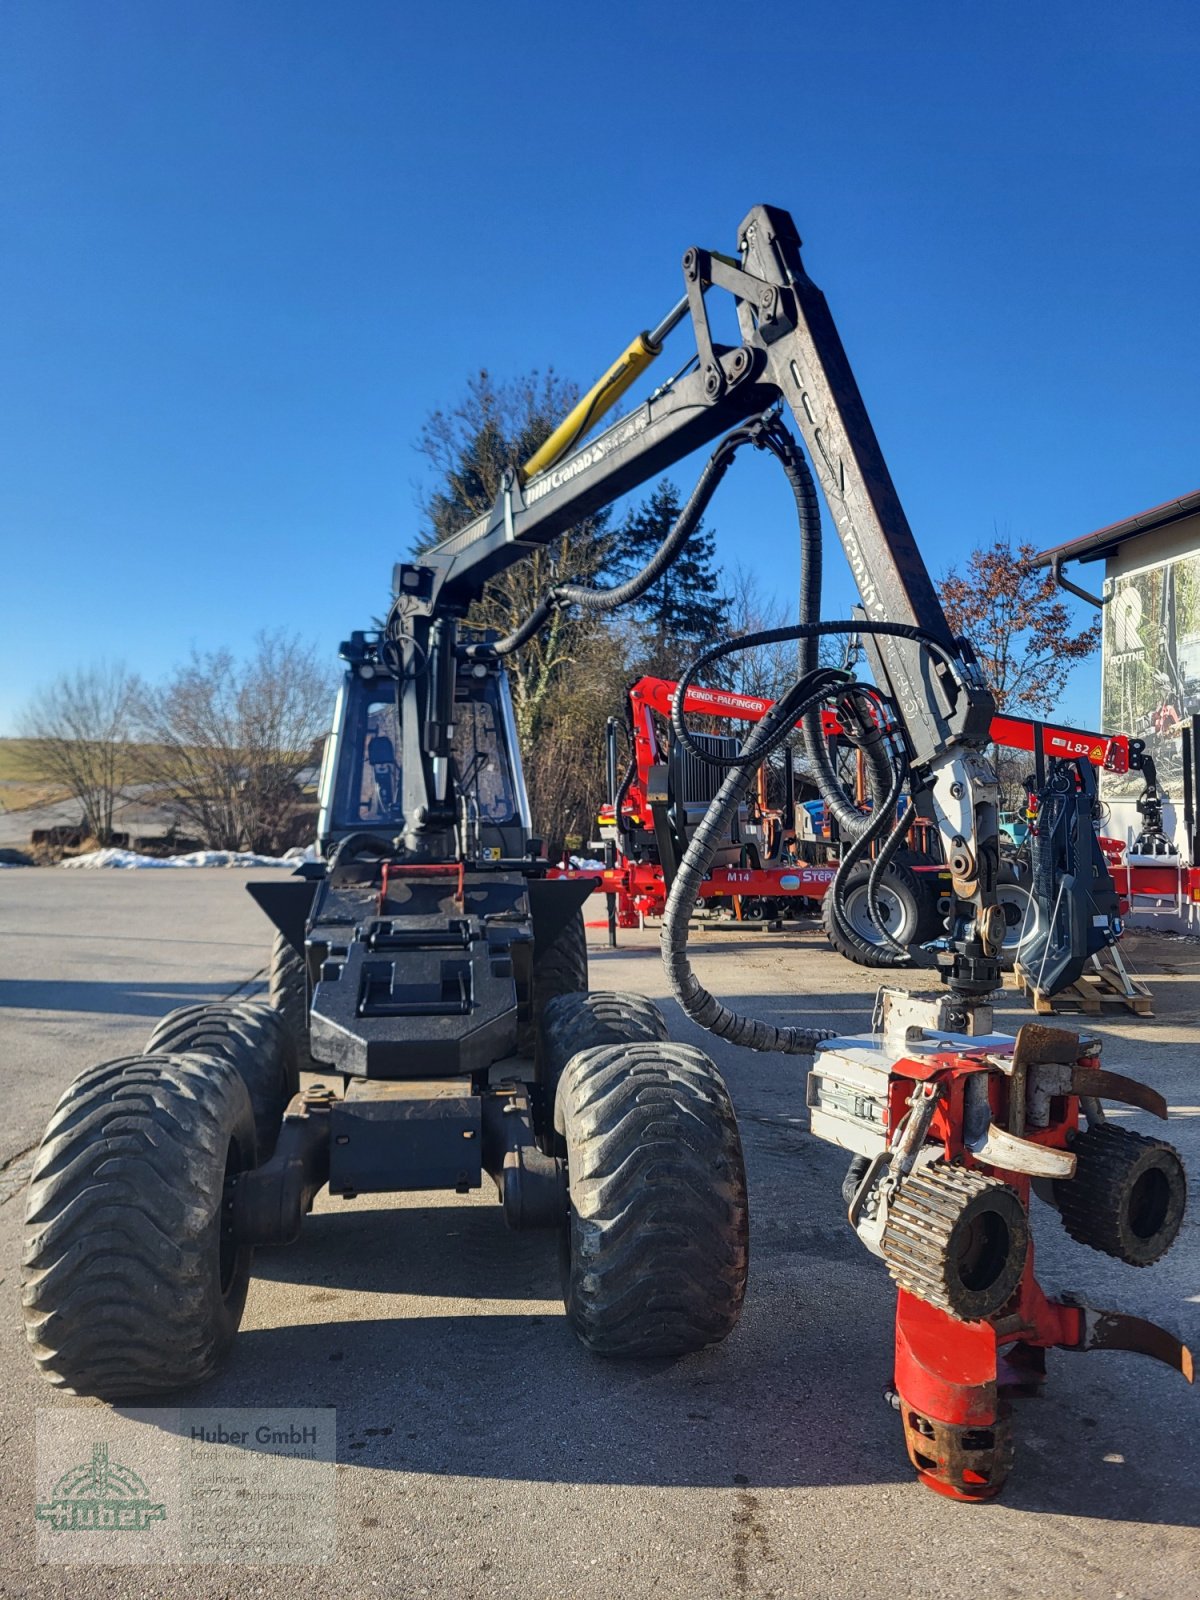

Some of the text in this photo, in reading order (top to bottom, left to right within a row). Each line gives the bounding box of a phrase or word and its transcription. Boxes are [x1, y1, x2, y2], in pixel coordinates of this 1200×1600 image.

[551, 452, 593, 488] Cranab
[1110, 651, 1145, 665] ROTTNE
[686, 689, 763, 711] TEINDL-PALFINGER
